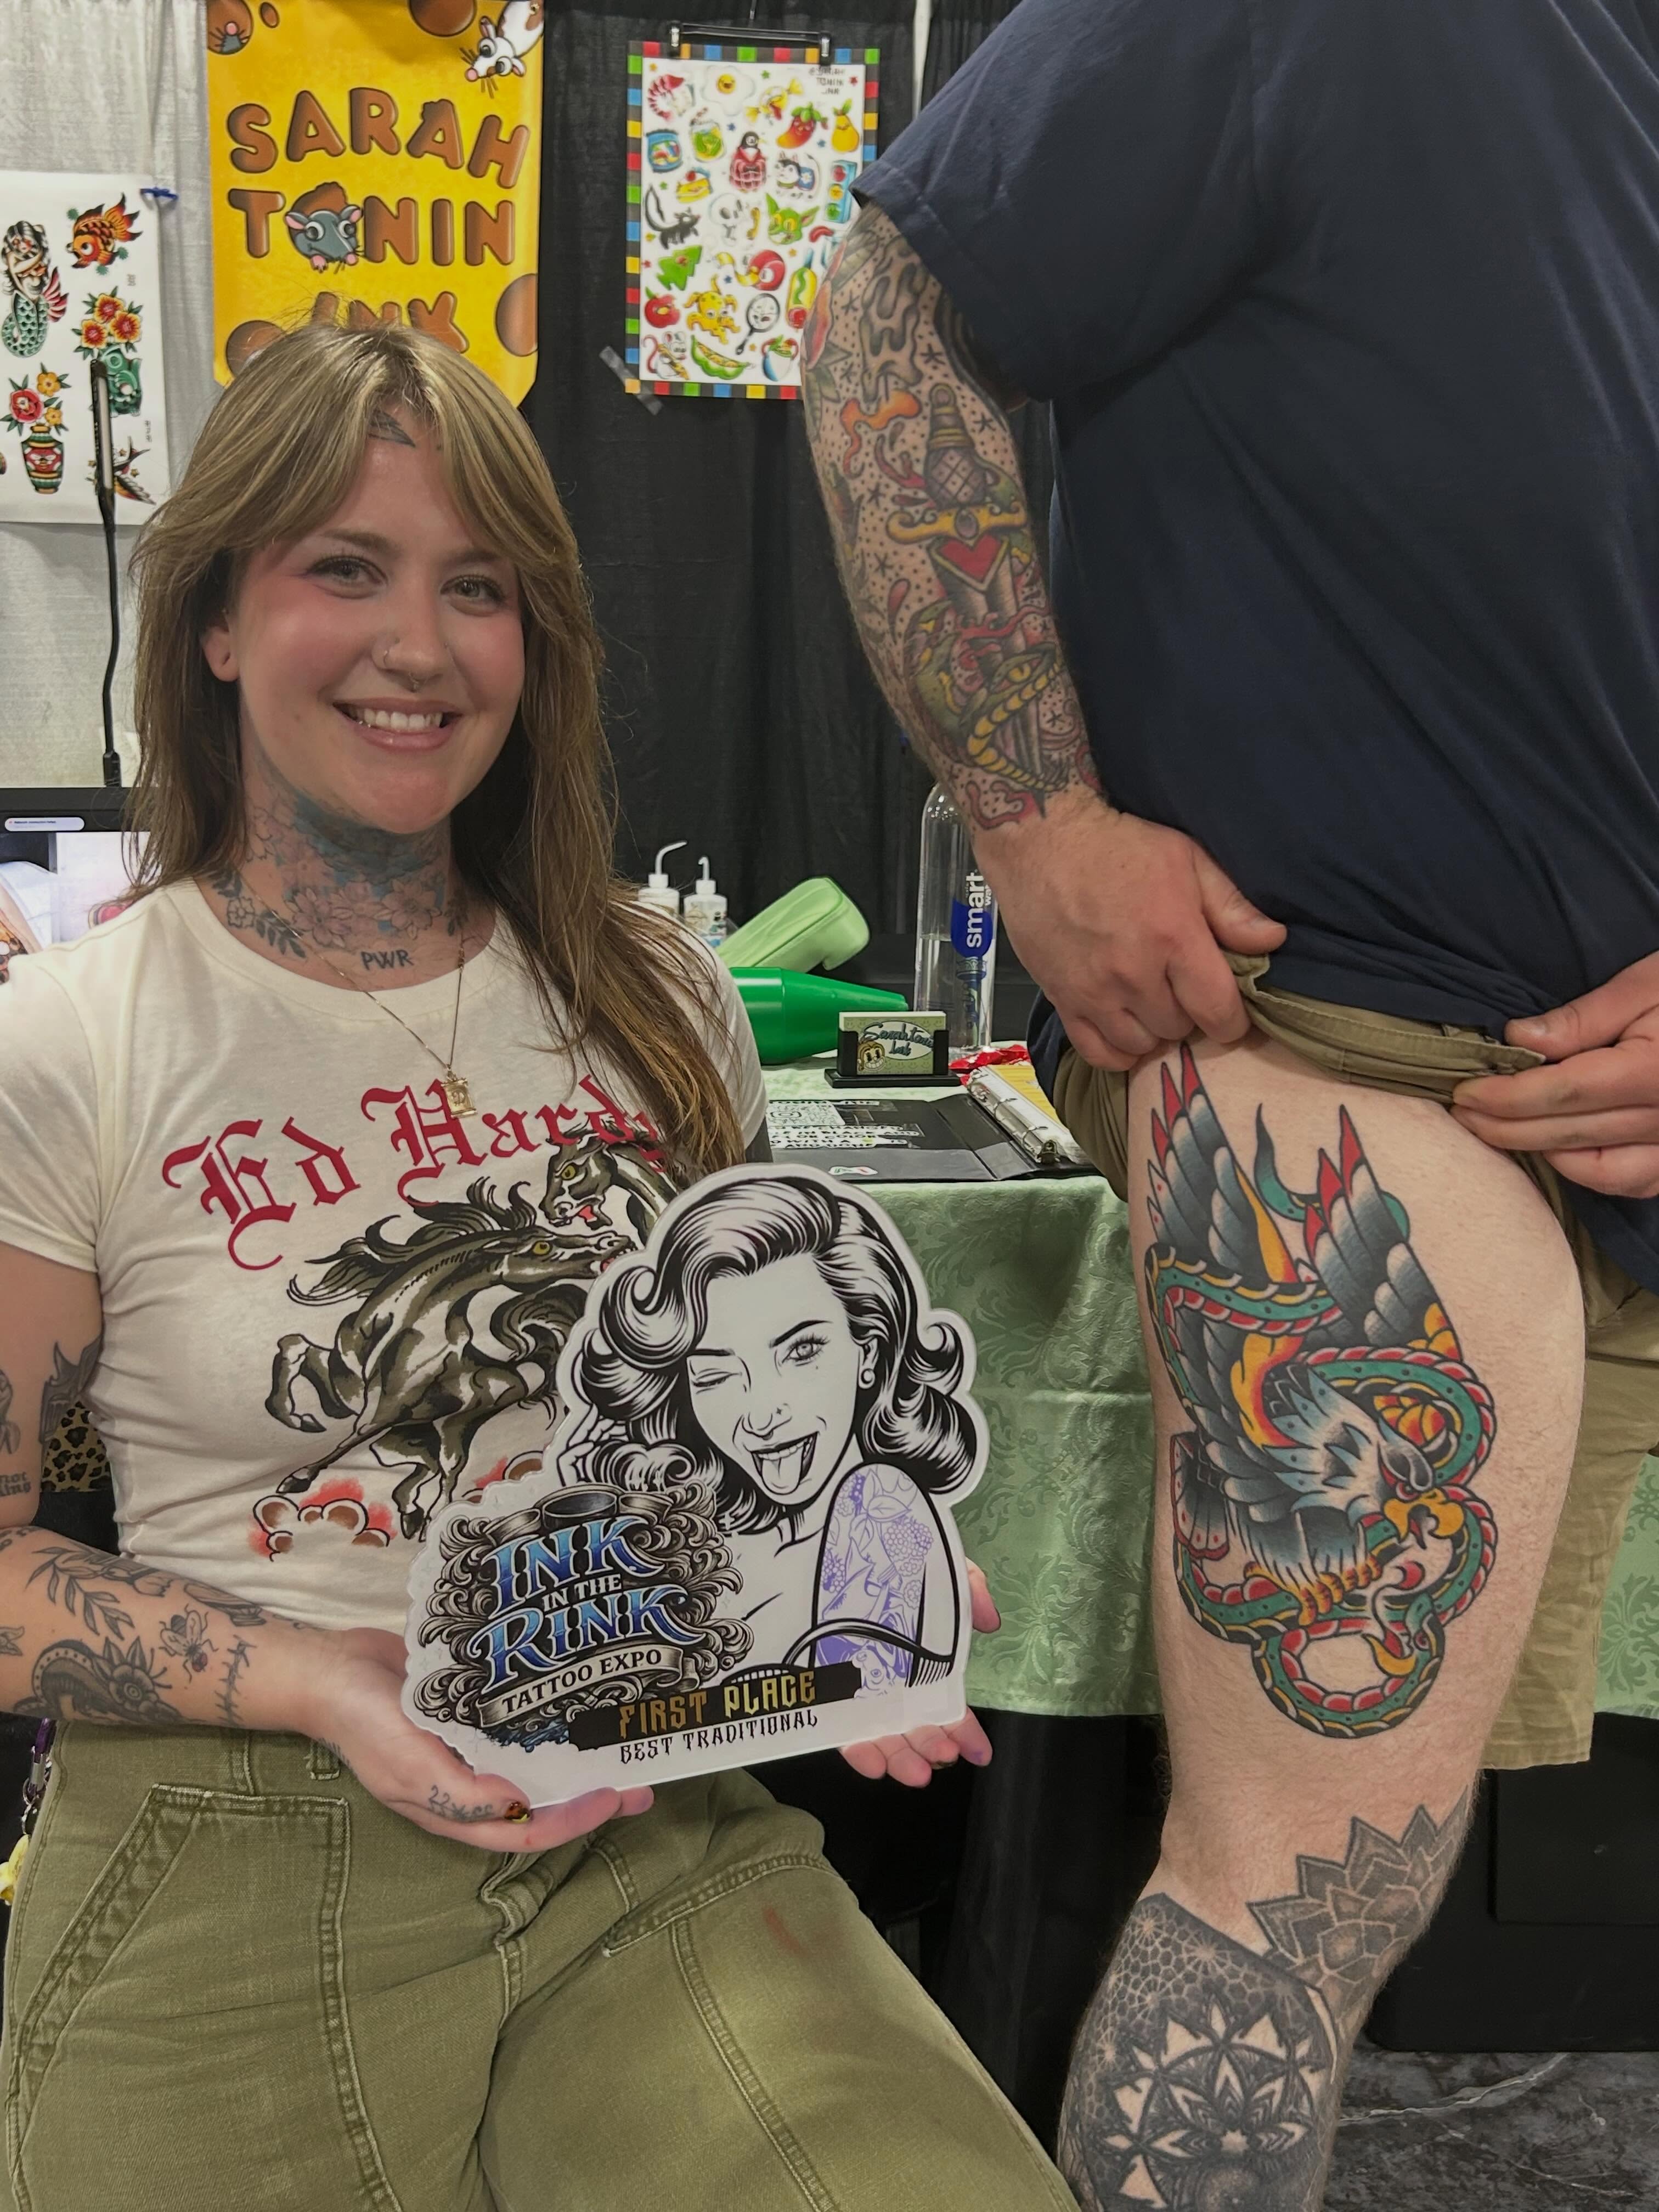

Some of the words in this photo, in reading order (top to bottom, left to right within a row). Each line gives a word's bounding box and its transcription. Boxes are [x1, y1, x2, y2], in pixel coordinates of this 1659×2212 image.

[226, 87, 531, 190] SARAH
[966, 872, 984, 949] smart
[360, 949, 415, 970] PWR
[860, 1021, 934, 1048] Sarahtoni
[162, 1116, 361, 1271] Ed
[482, 1515, 665, 1620] INK
[543, 1593, 568, 1612] IN
[573, 1573, 622, 1600] THE
[467, 1584, 707, 1694] RINK
[501, 1664, 593, 1716] TATTOO
[600, 1647, 662, 1677] EXPO
[619, 1691, 708, 1740] FIRST
[723, 1671, 816, 1719] PLACE
[620, 1736, 673, 1765] BEST
[682, 1709, 818, 1752] TRADITIONAL
